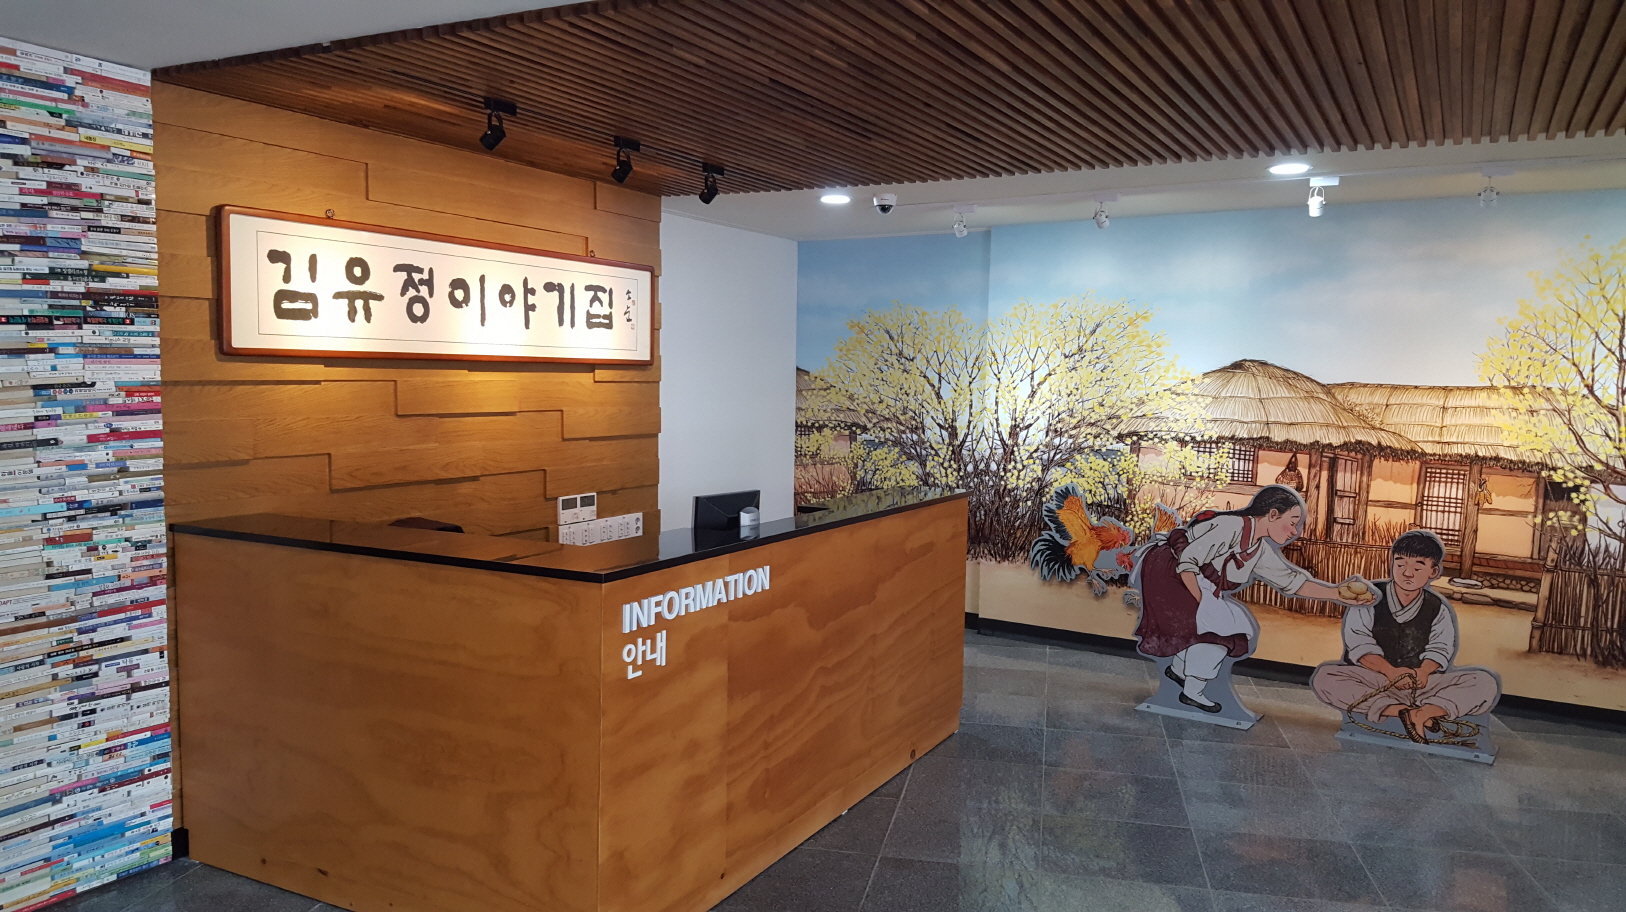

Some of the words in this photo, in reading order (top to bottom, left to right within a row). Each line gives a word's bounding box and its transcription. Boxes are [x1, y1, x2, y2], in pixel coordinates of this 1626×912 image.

[266, 249, 613, 330] 김유정이야기집
[622, 565, 770, 634] INFORMATION
[622, 630, 667, 680] 안내
